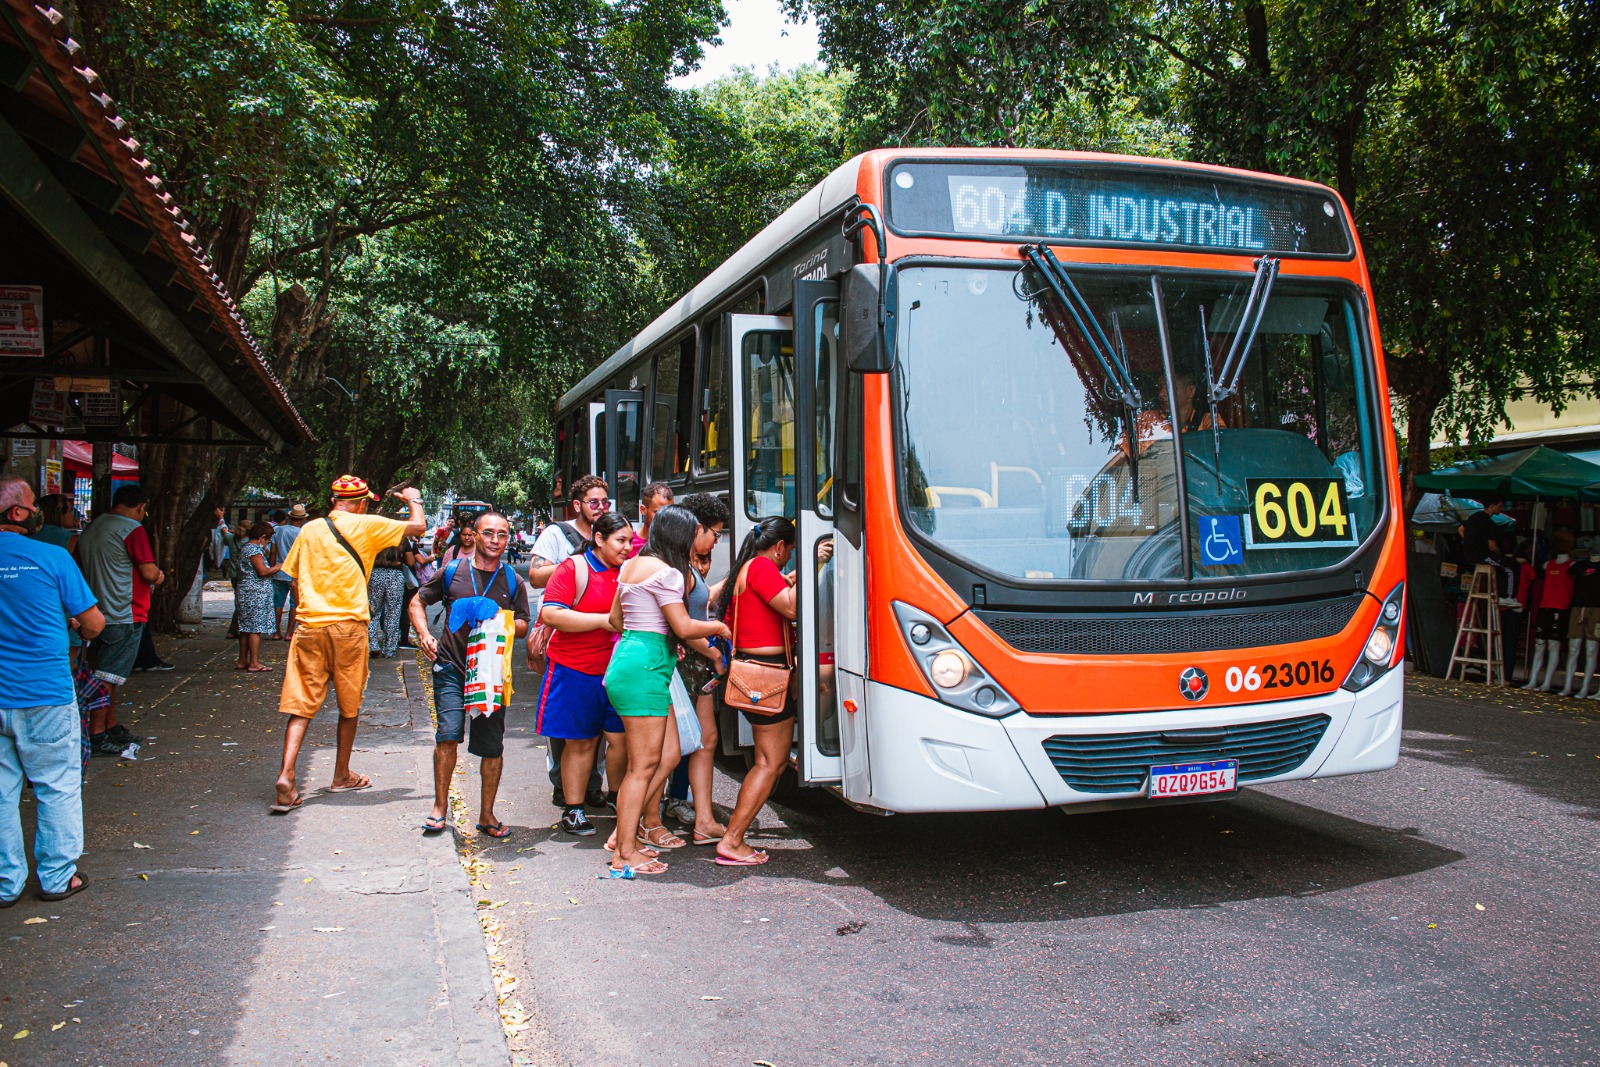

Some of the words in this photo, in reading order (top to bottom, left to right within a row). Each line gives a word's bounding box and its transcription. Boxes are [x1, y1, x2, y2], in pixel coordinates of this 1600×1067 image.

[956, 185, 1030, 232] 604
[1047, 191, 1074, 234] D.
[1089, 194, 1264, 248] INDUSTRIAL
[793, 248, 828, 277] Torino
[1066, 474, 1142, 527] 604
[1255, 482, 1347, 539] 604
[1133, 588, 1247, 605] Mrcopolo
[1225, 659, 1335, 693] 0623016
[1158, 771, 1227, 794] QZQ9G54
